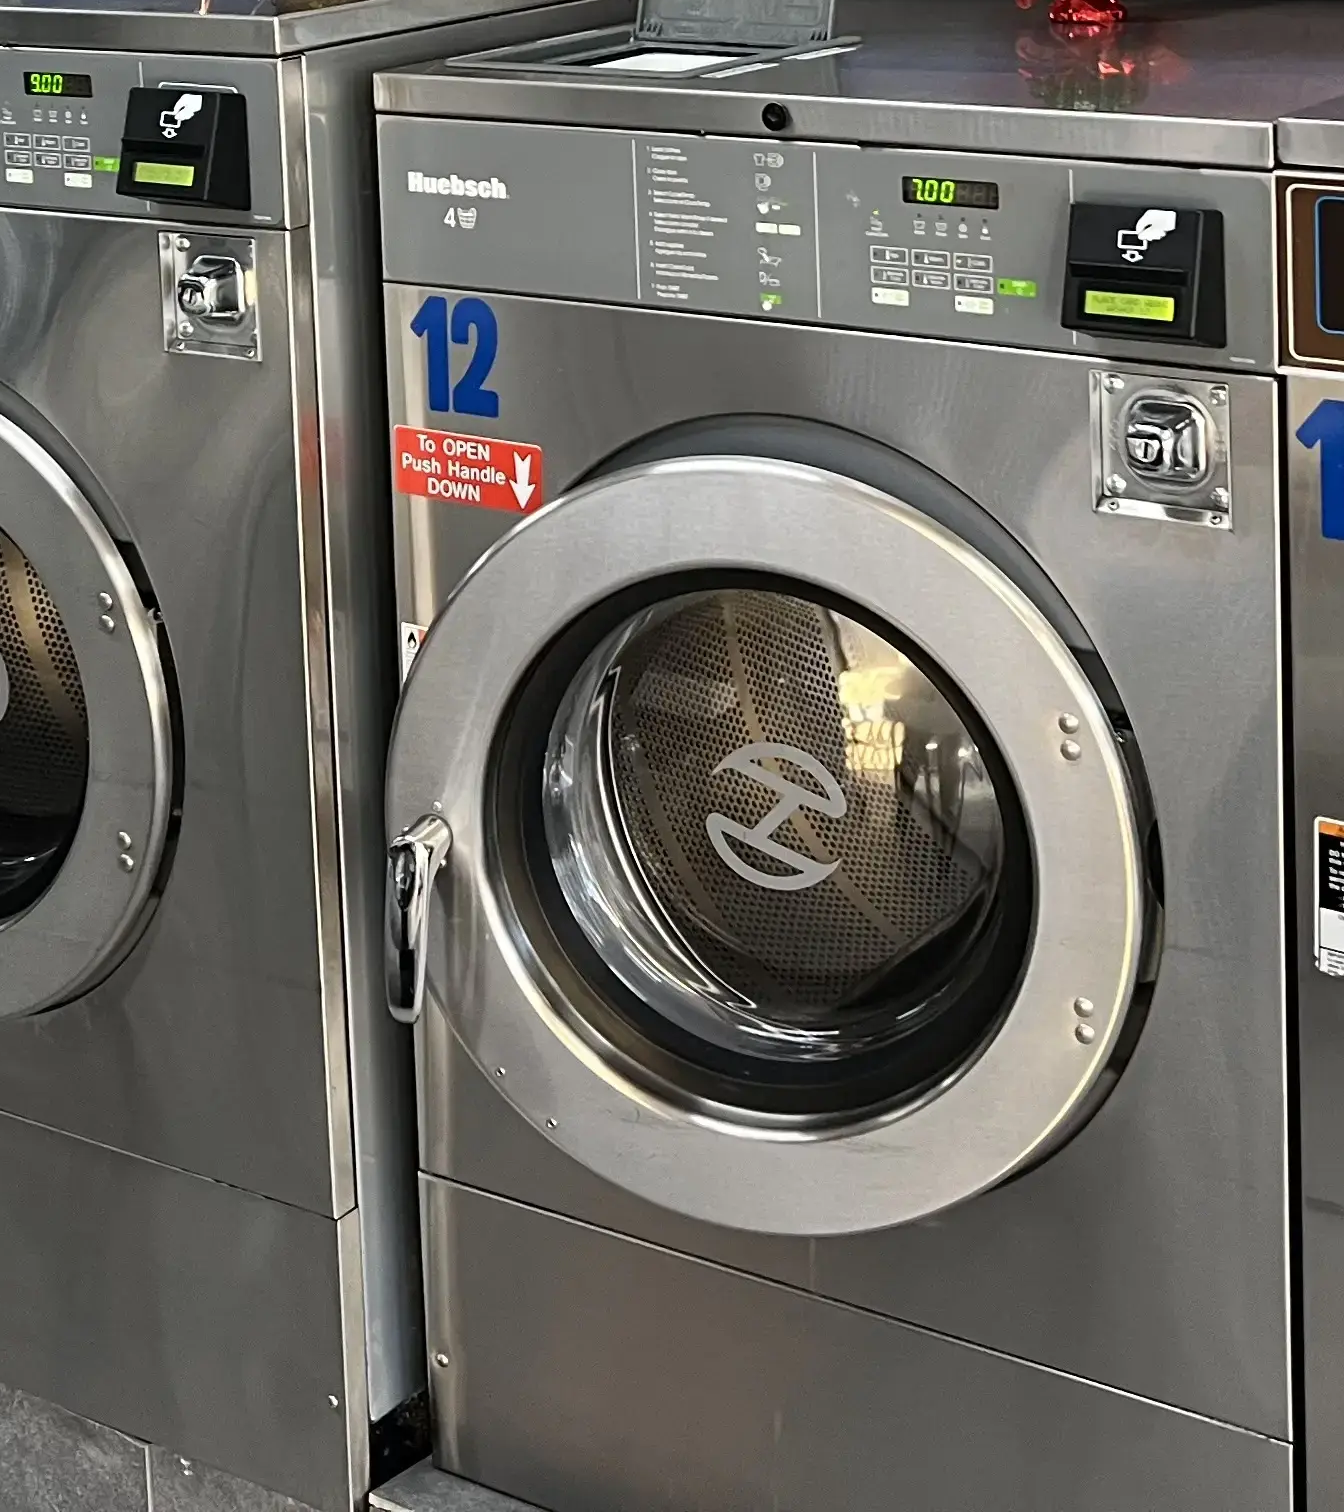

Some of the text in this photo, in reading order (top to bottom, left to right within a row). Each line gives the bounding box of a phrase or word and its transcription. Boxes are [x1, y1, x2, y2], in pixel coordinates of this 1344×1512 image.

[407, 170, 510, 201] Huebsch
[443, 207, 457, 229] 4
[409, 294, 501, 419] 12
[416, 432, 492, 463] To OPEN
[400, 452, 507, 488] Push Handle
[426, 477, 482, 504] DOWN
